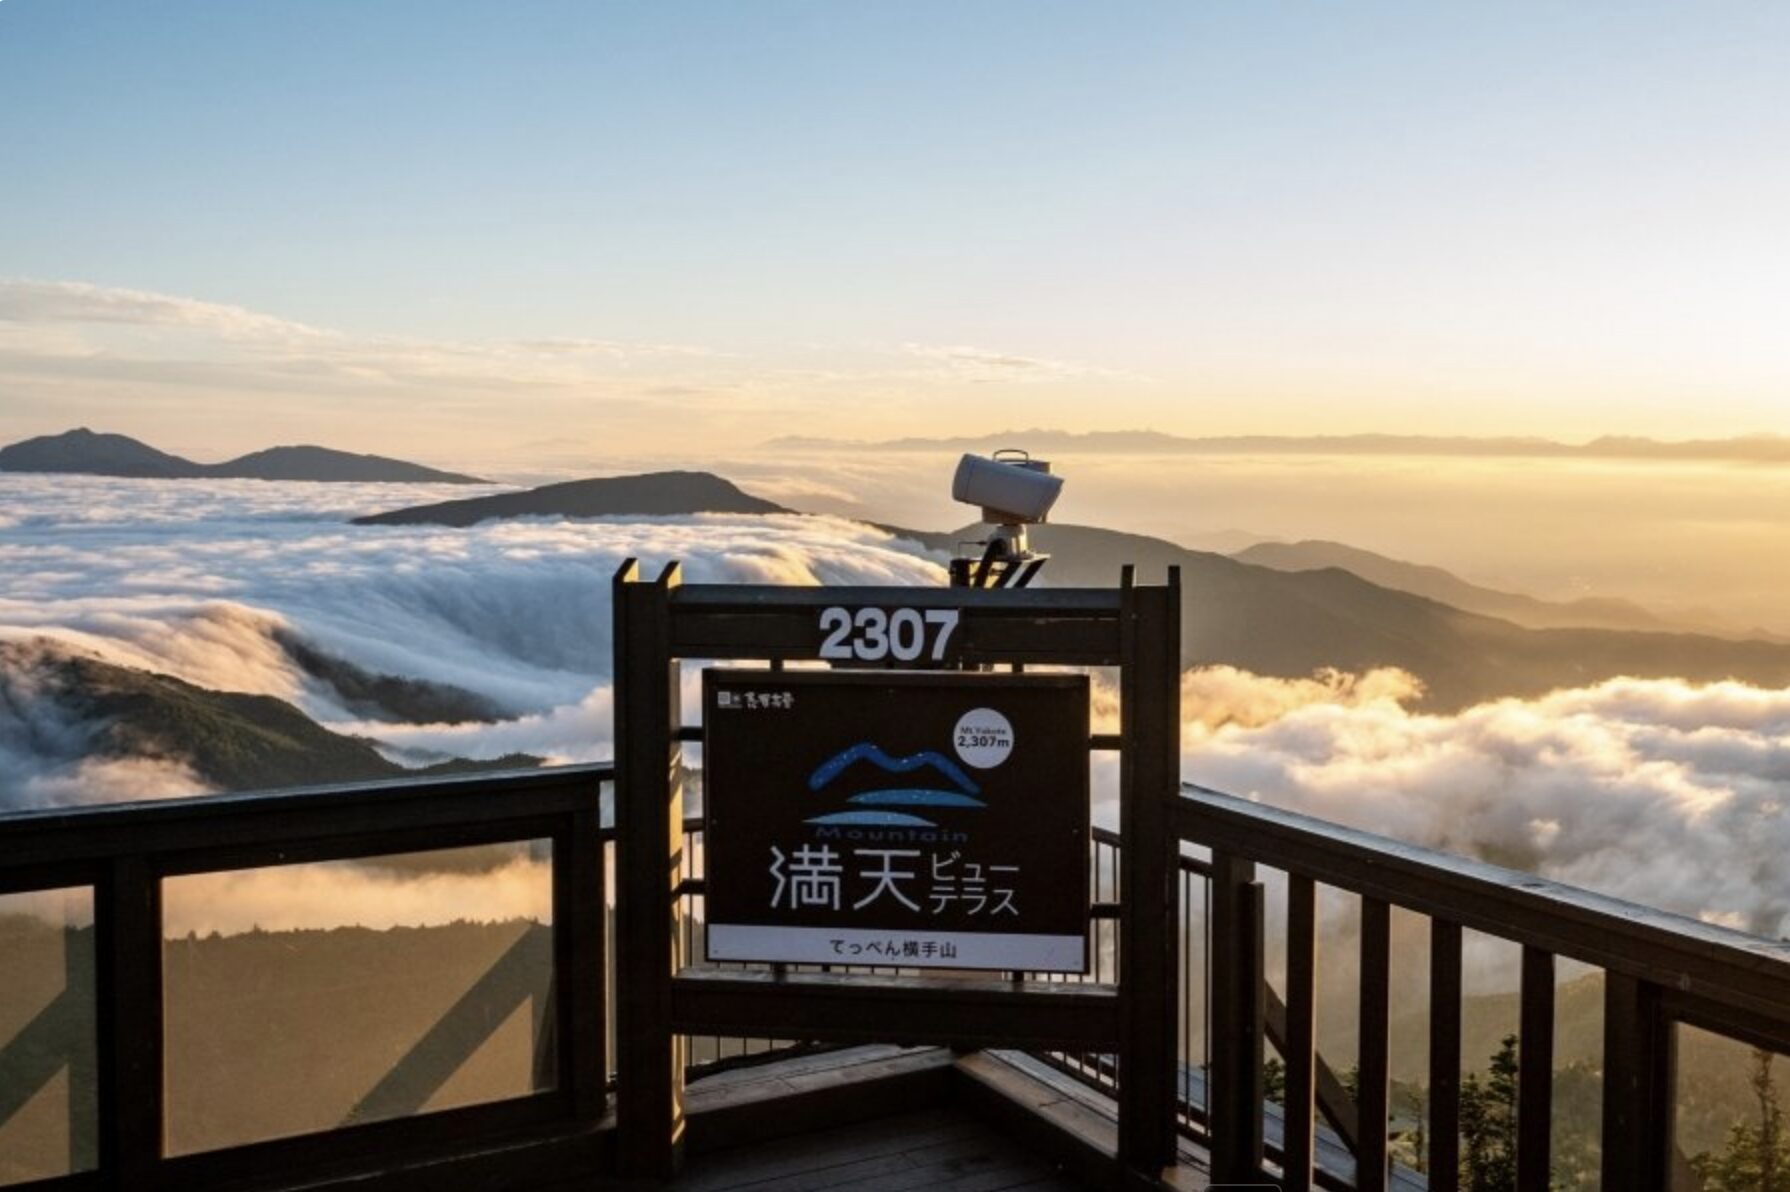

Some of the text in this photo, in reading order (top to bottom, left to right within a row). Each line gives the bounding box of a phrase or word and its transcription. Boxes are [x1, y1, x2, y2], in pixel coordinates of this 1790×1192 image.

[819, 607, 959, 661] 2307
[958, 735, 1009, 748] 2,307m
[816, 827, 968, 843] Mountain
[769, 844, 921, 912] 満天
[932, 850, 1019, 881] ビュー
[930, 886, 1019, 915] テラス
[829, 939, 957, 959] てっぺん横手山
